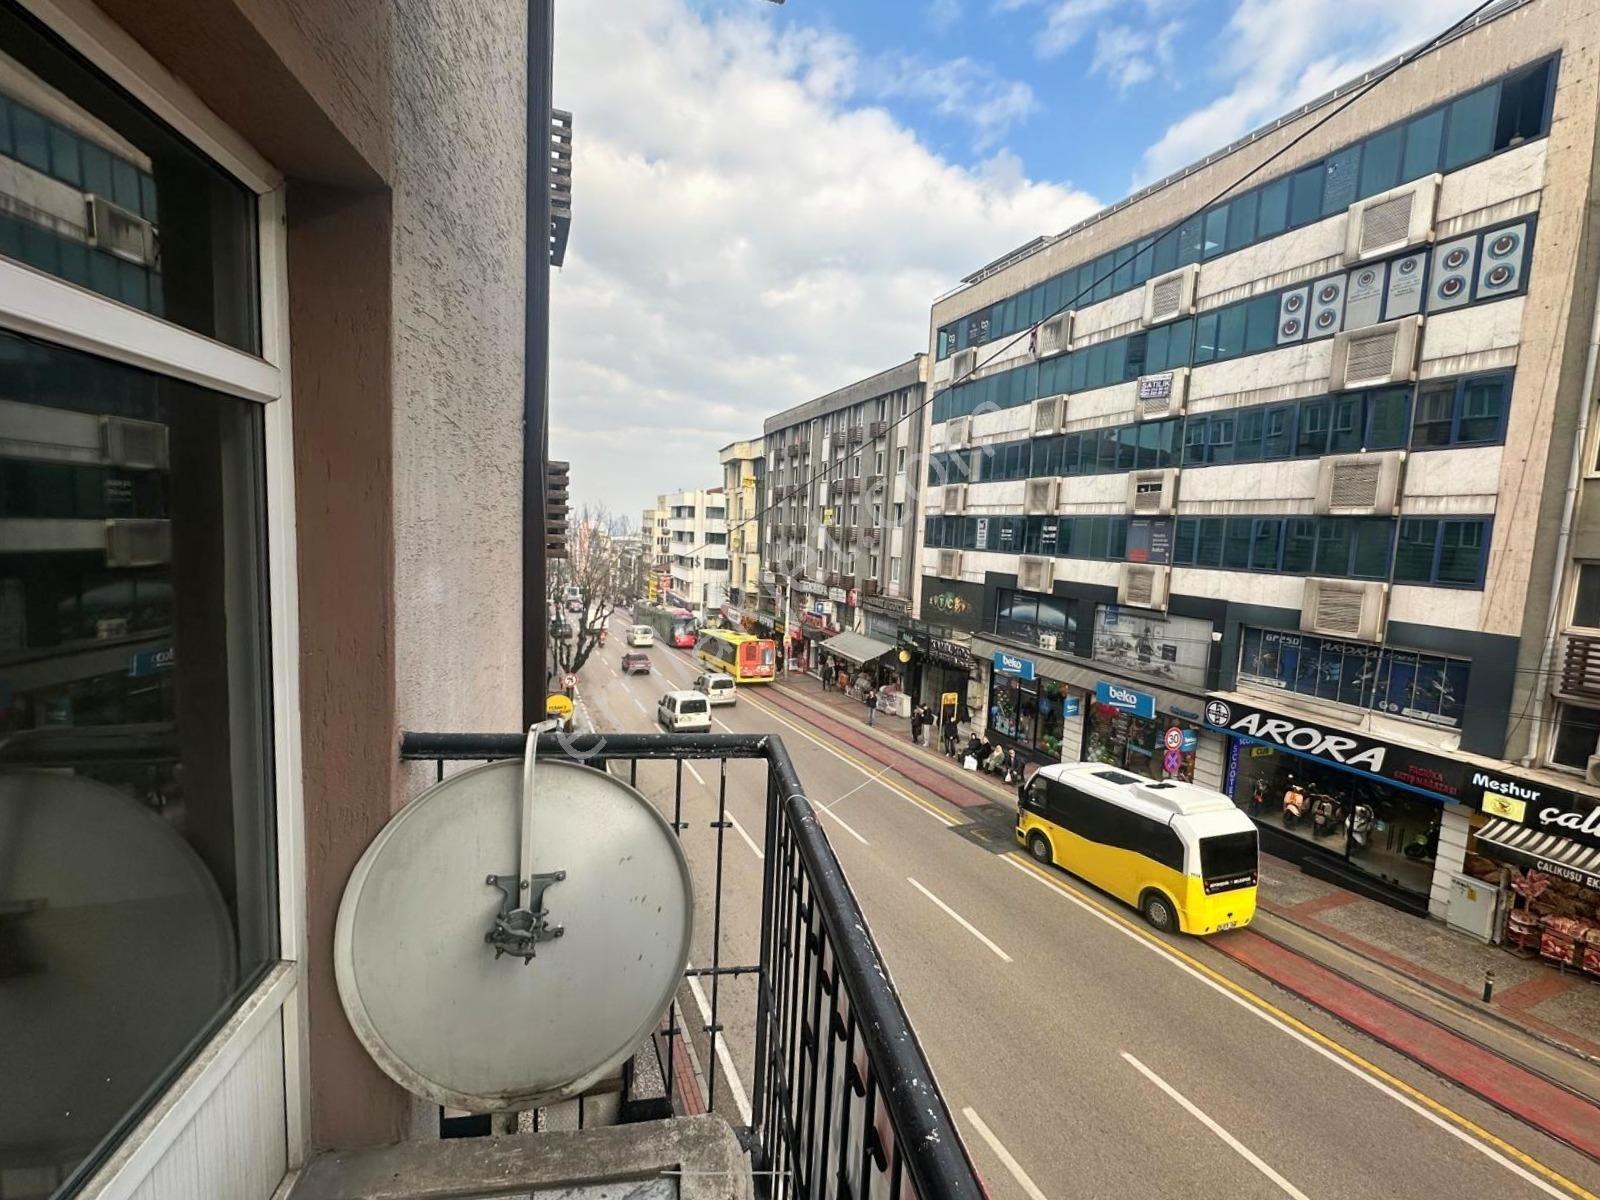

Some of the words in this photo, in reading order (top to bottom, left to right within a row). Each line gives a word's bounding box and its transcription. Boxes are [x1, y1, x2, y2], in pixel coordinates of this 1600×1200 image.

[1002, 655, 1022, 669] beko
[1108, 686, 1137, 705] beko
[1168, 734, 1179, 745] 30
[1230, 713, 1386, 773] ARORA
[1472, 772, 1541, 802] Meşhur
[1586, 877, 1600, 889] EK
